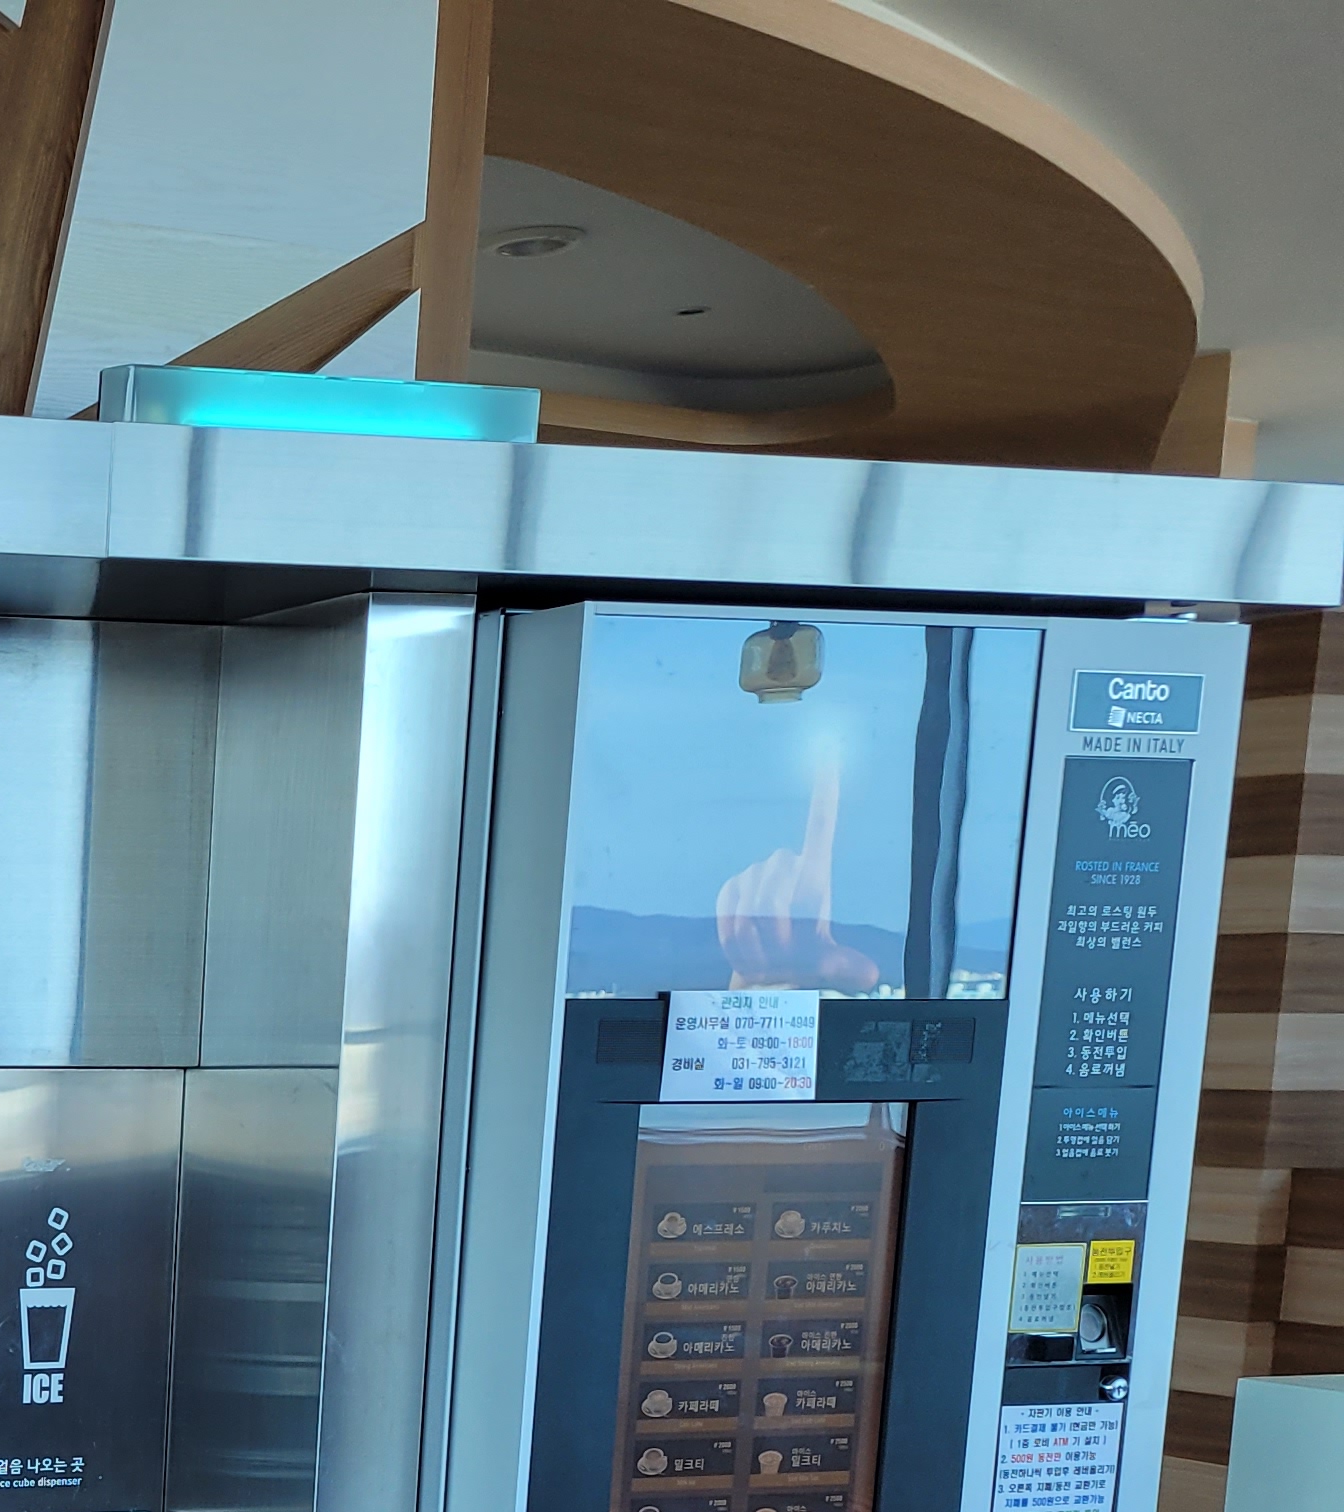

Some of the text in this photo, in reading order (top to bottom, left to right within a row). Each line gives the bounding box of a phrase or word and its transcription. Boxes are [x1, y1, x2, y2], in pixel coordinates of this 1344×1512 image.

[1109, 678, 1169, 701] Canto
[1127, 711, 1163, 725] NECTA
[1082, 736, 1185, 754] MADE IN ITALY
[1075, 861, 1160, 872] ROSTED IN FRANCE
[1091, 874, 1141, 885] SINCE 1928
[675, 1017, 815, 1030] 운영사무실 070-7711-4949
[672, 1057, 806, 1071] 경비실 031-795-3121
[22, 1373, 64, 1404] ICE
[27, 1457, 67, 1474] 나오는
[70, 1457, 85, 1473] 곳
[13, 1478, 35, 1487] cube
[38, 1477, 82, 1487] dispenser
